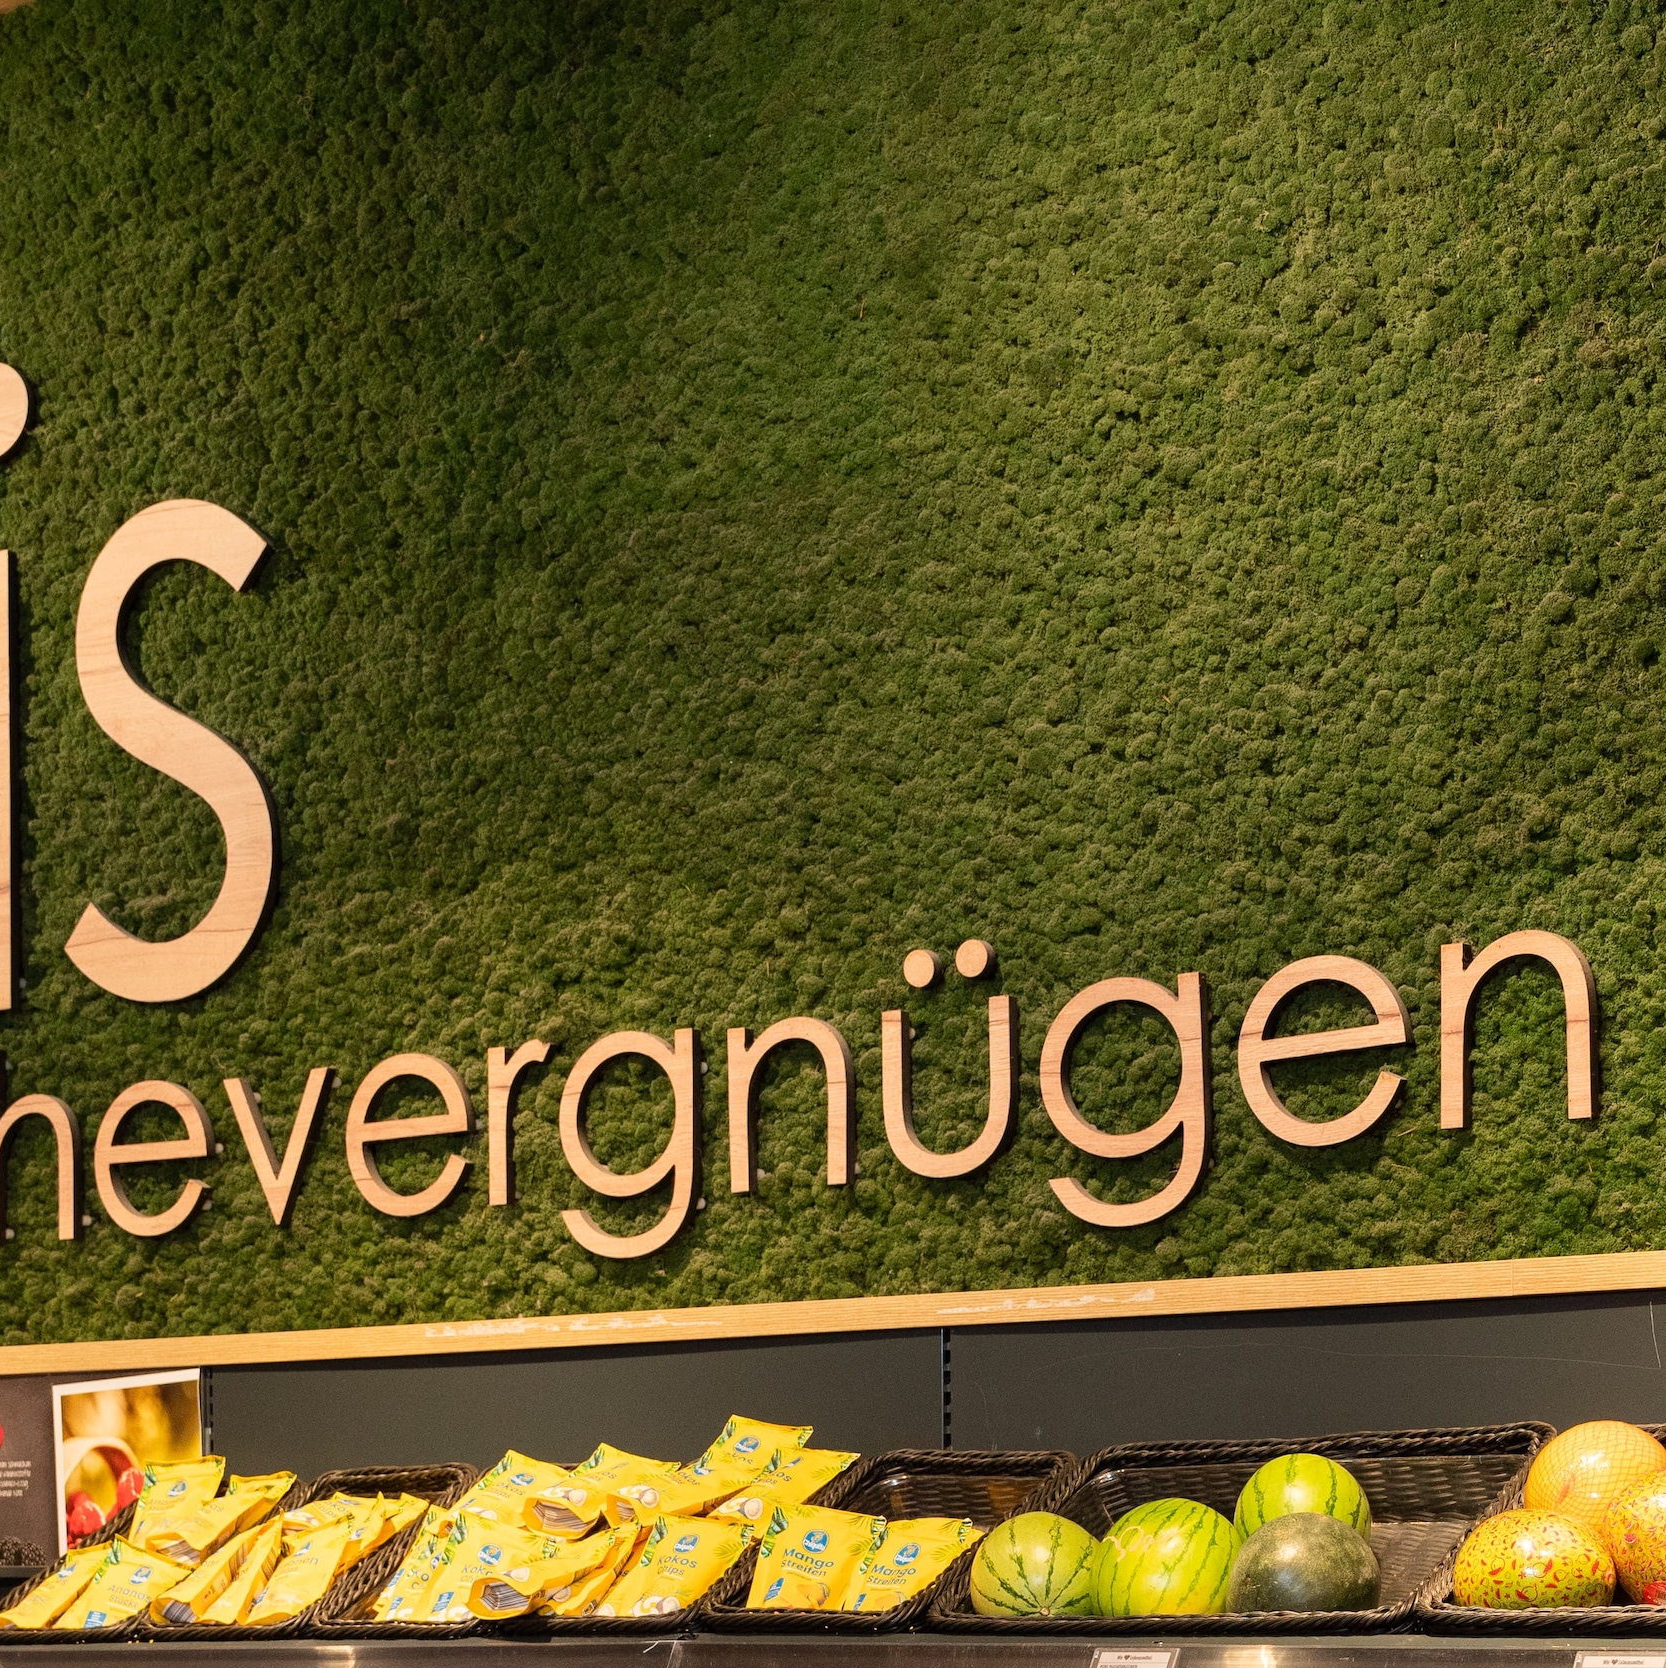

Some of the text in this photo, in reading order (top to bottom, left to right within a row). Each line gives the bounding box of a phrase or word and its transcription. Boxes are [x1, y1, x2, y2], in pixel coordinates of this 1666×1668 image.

[658, 1555, 698, 1569] Kokos
[783, 1548, 834, 1568] Mango
[781, 1560, 827, 1577] Streifen
[871, 1564, 917, 1577] Mango
[866, 1574, 907, 1585] Streifen
[108, 1584, 153, 1603] Ananas
